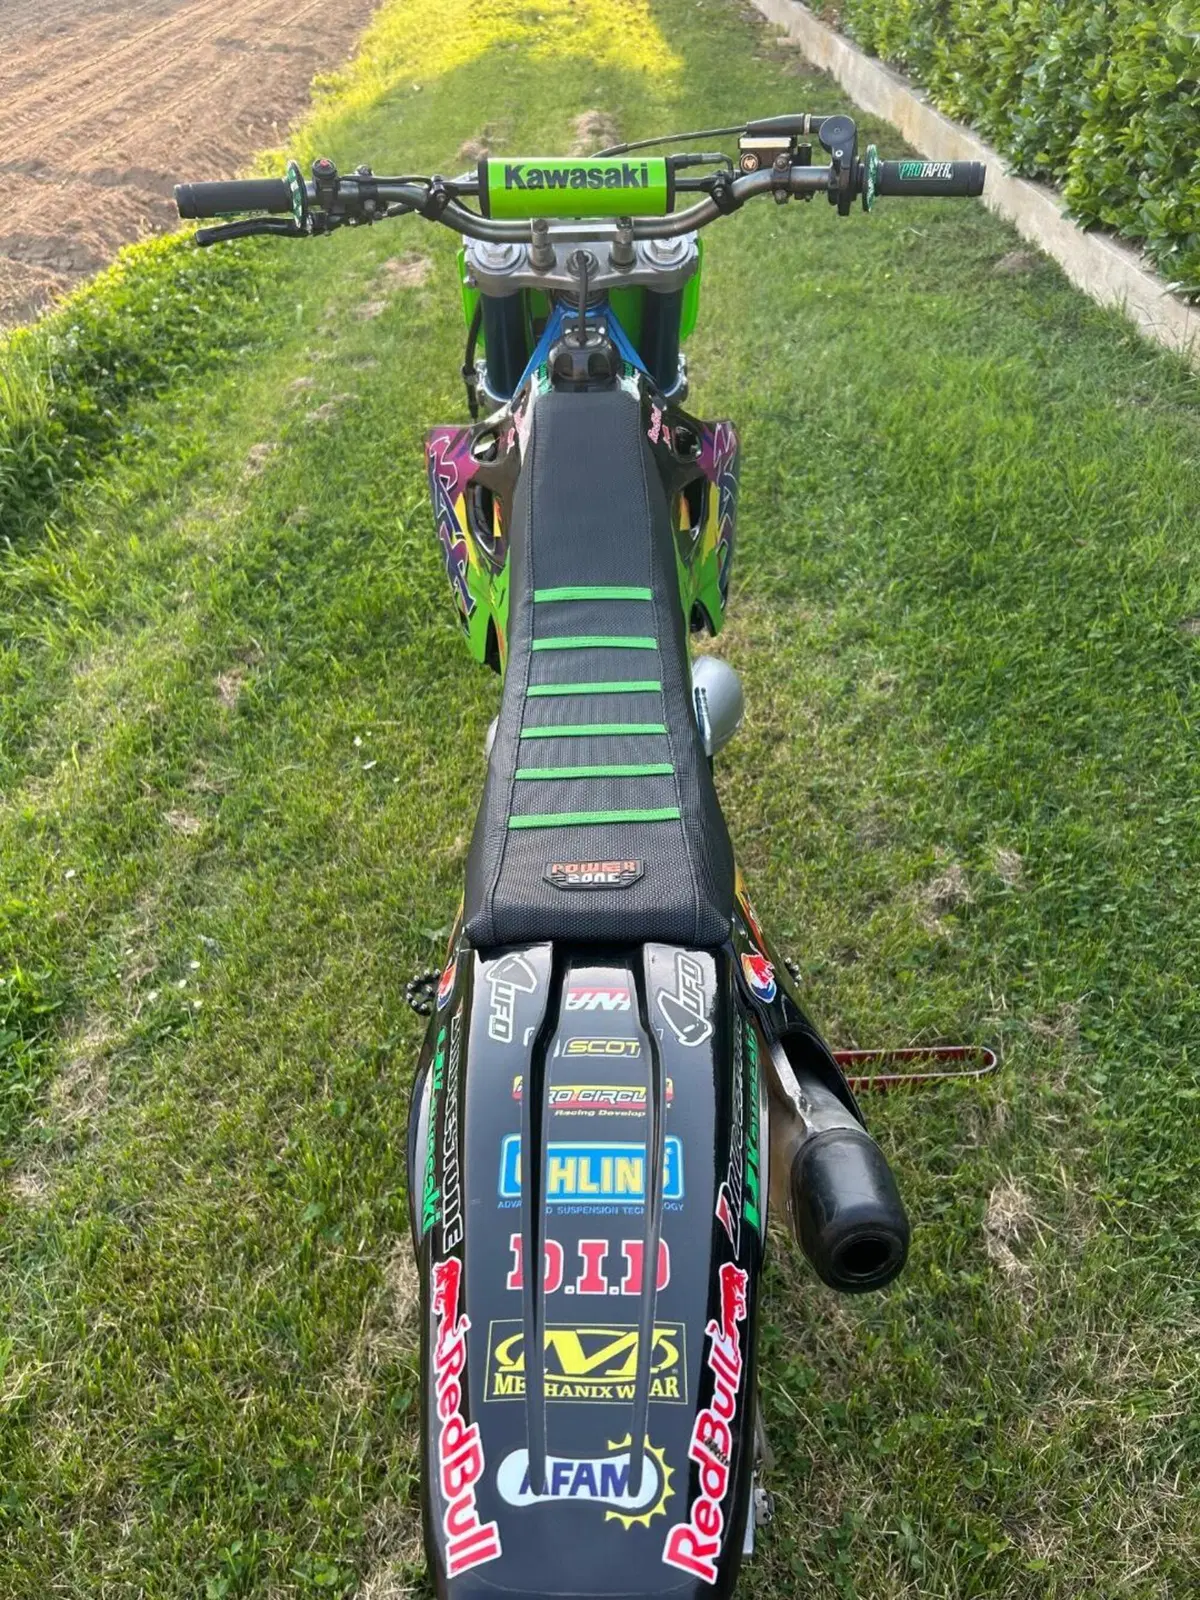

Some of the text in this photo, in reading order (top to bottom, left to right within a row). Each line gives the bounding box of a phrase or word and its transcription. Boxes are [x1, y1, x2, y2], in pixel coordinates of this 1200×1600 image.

[505, 162, 649, 189] Kawasaki
[551, 861, 636, 874] POWER
[568, 873, 620, 884] ZONE
[677, 953, 706, 1022] UFO
[488, 984, 516, 1043] UFO
[567, 1040, 640, 1054] SCOT
[578, 1089, 647, 1105] CIRCU
[598, 1109, 646, 1118] Develop
[557, 1205, 618, 1215] SUSPENSION
[623, 1202, 684, 1215] TECOGY
[493, 1372, 680, 1399] MEHANIX WAR
